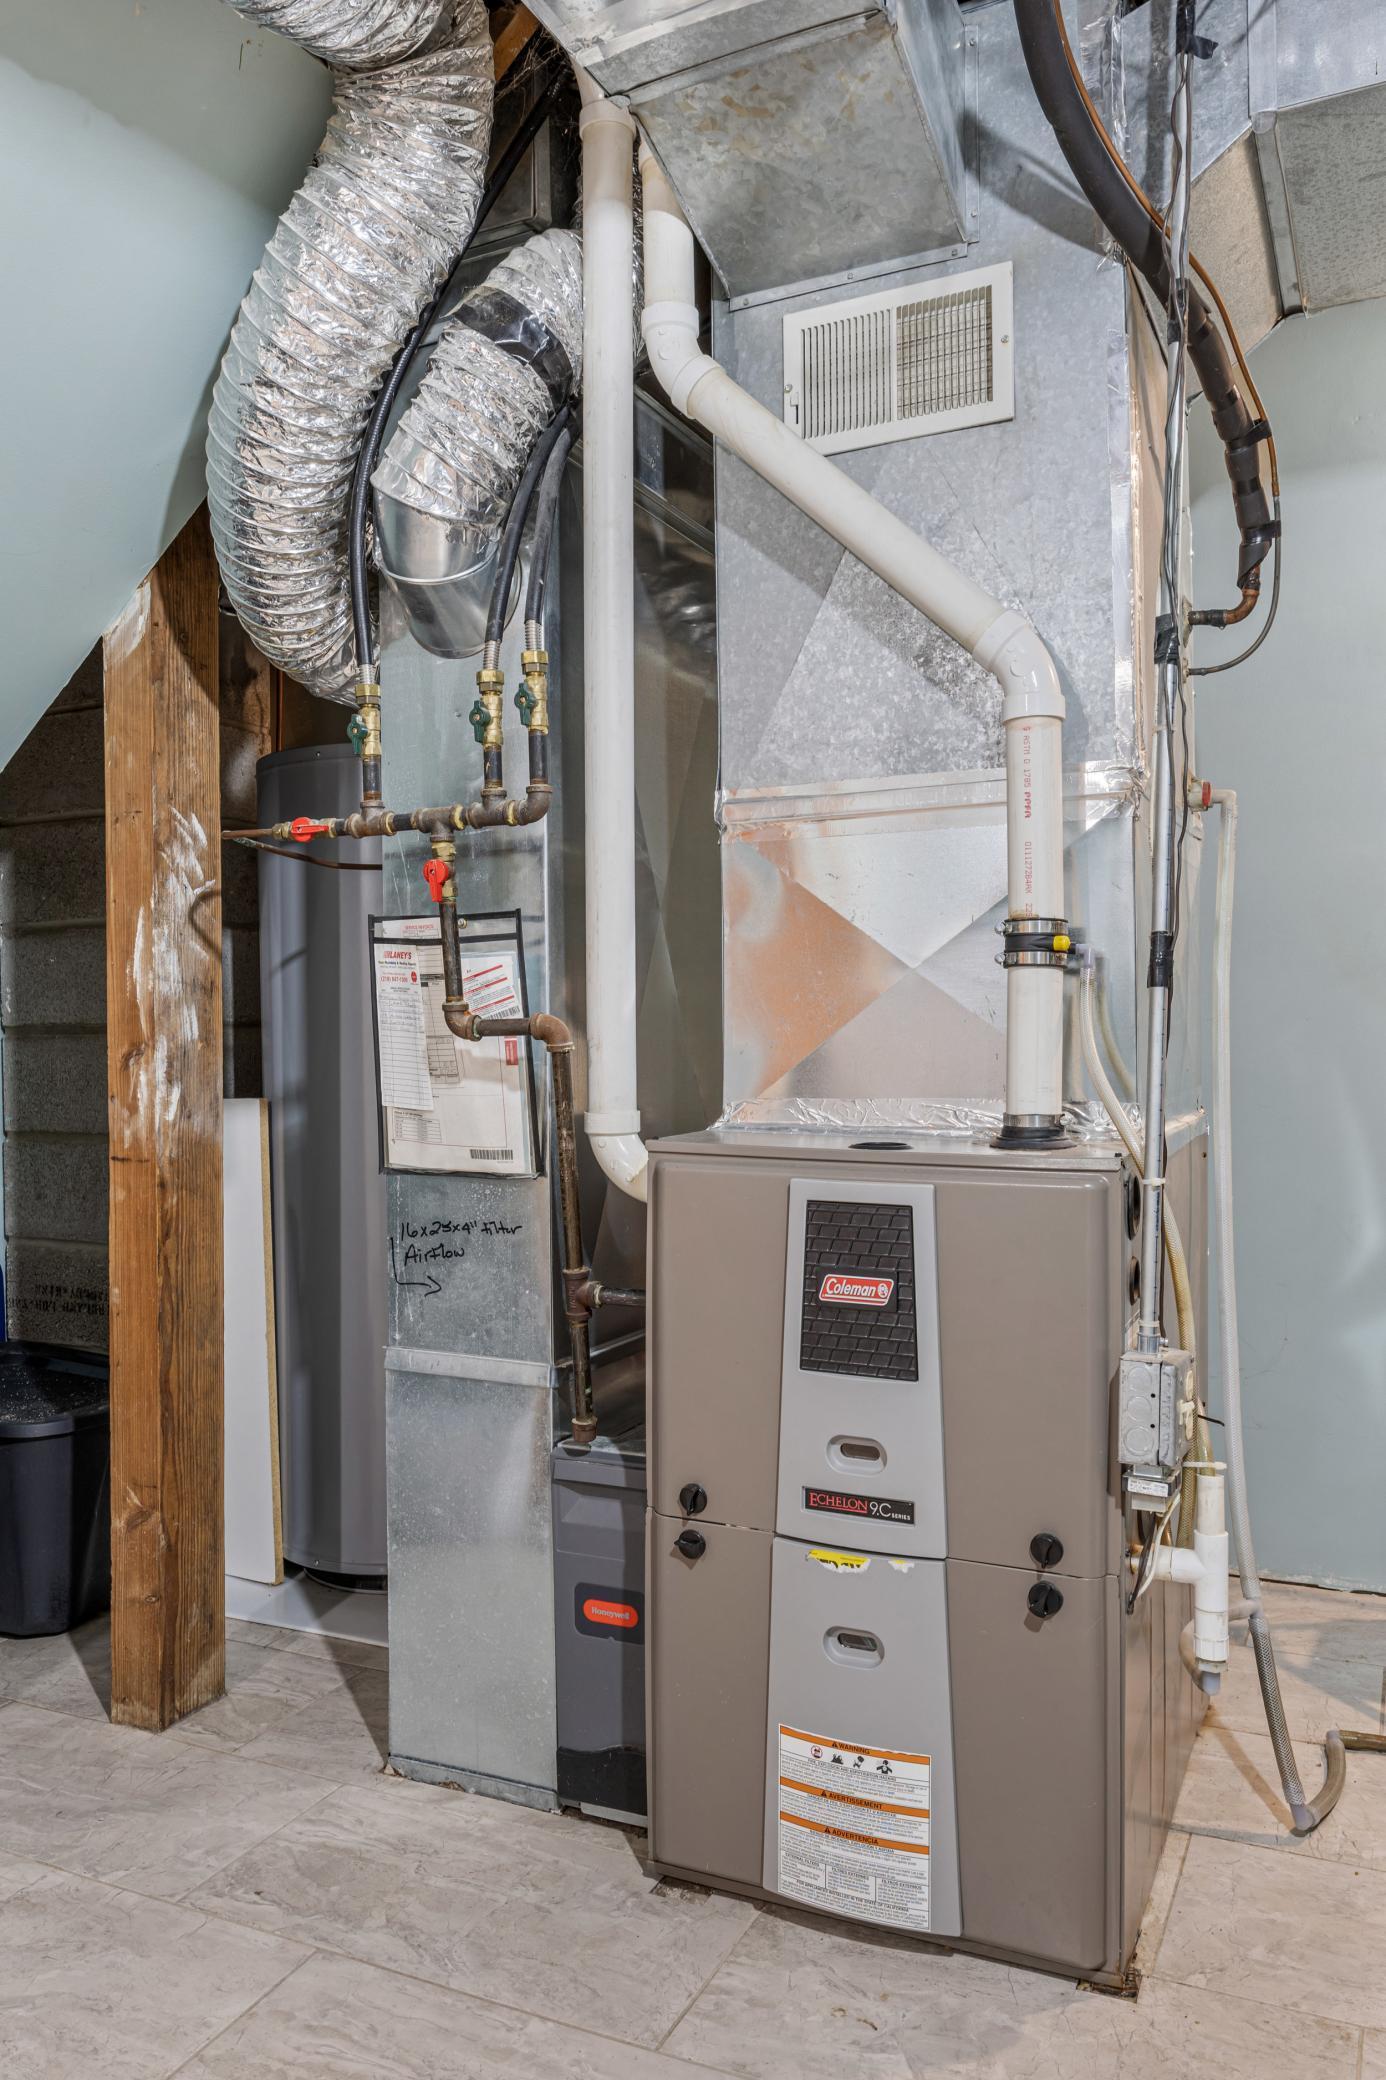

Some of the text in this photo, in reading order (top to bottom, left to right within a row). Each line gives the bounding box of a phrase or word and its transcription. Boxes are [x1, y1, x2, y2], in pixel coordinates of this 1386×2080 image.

[1023, 769, 1032, 788] 1785
[826, 1278, 877, 1297] Coleman
[809, 1492, 868, 1511] ECHELON
[891, 1513, 911, 1521] SERIES
[591, 1606, 631, 1621] Honeywell
[839, 1743, 870, 1755] WARNING
[829, 1791, 882, 1809] AVERTISSEMENT
[832, 1828, 879, 1845] ADVERTENCIA
